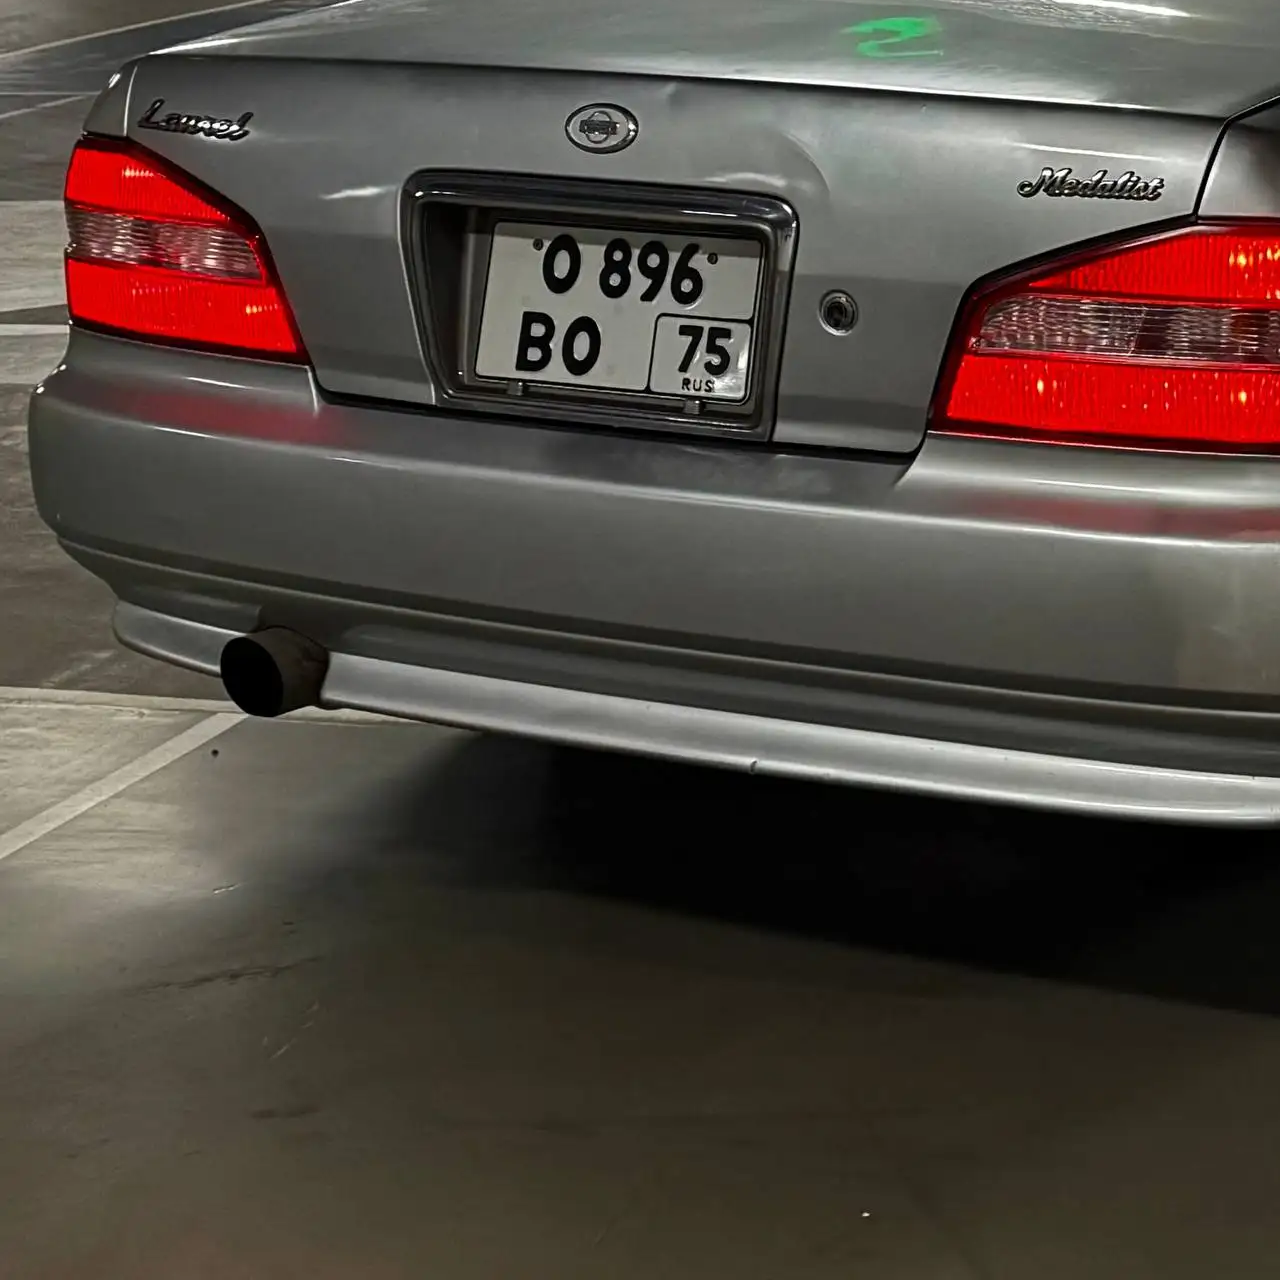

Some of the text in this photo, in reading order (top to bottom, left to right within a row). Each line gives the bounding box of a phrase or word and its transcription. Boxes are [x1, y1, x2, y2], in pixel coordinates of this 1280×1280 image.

[1017, 166, 1165, 201] Medalist
[599, 237, 704, 305] 896
[515, 311, 732, 377] BO 75
[681, 377, 714, 393] RUS
